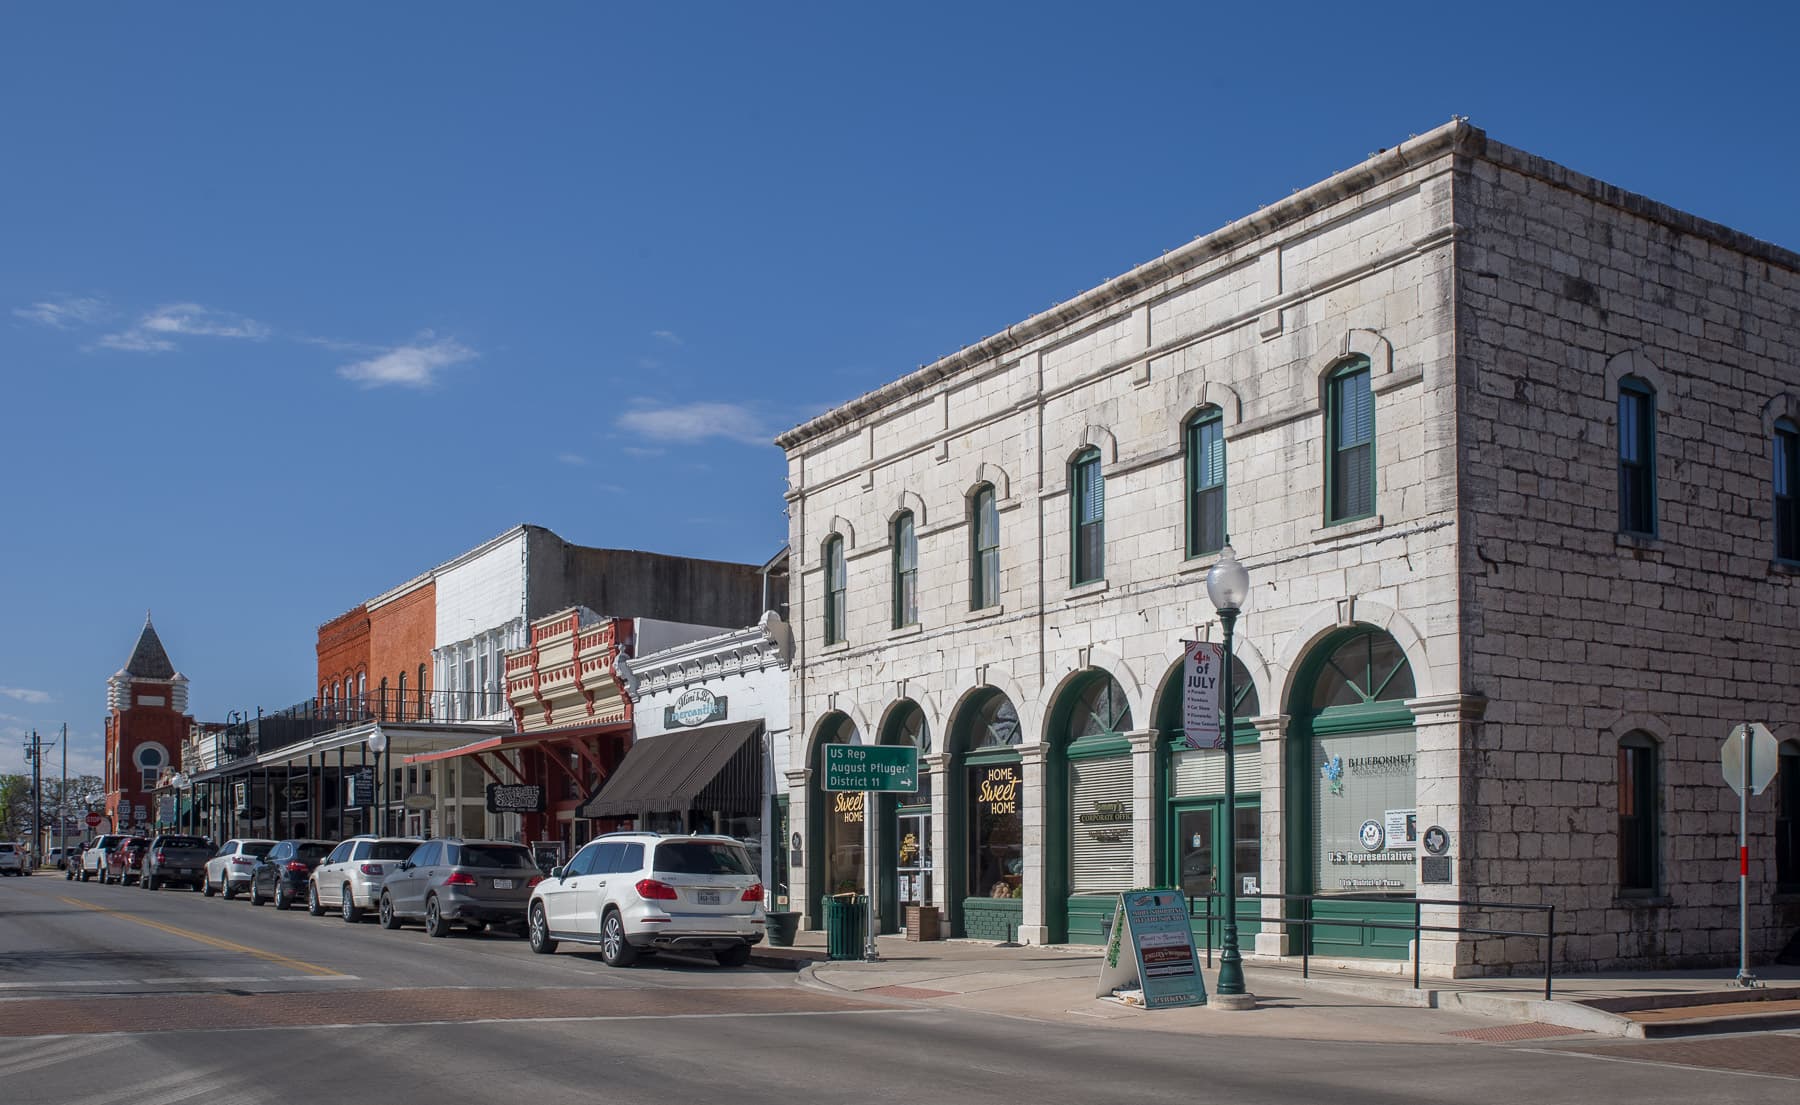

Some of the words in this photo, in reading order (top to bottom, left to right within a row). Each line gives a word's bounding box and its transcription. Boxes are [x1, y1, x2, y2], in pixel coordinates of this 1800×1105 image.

[1194, 651, 1210, 664] 4th
[1196, 663, 1209, 674] of
[1188, 676, 1216, 688] JULY
[830, 749, 843, 759] US
[847, 749, 866, 761] Rep
[1348, 753, 1413, 768] BLUEBONNET
[830, 762, 866, 775] August
[870, 763, 906, 776] Pfluger
[988, 767, 1013, 781] HOME
[830, 776, 868, 787] District
[871, 777, 880, 787] 11
[979, 776, 1022, 802] Sweet
[834, 792, 865, 813] Sweet
[991, 801, 1016, 815] HOME
[844, 811, 864, 823] HOME
[1081, 814, 1114, 822] CORPORATE
[1114, 812, 1133, 820] OFFIC
[1328, 852, 1345, 862] U.S.
[1347, 851, 1413, 864] Representative
